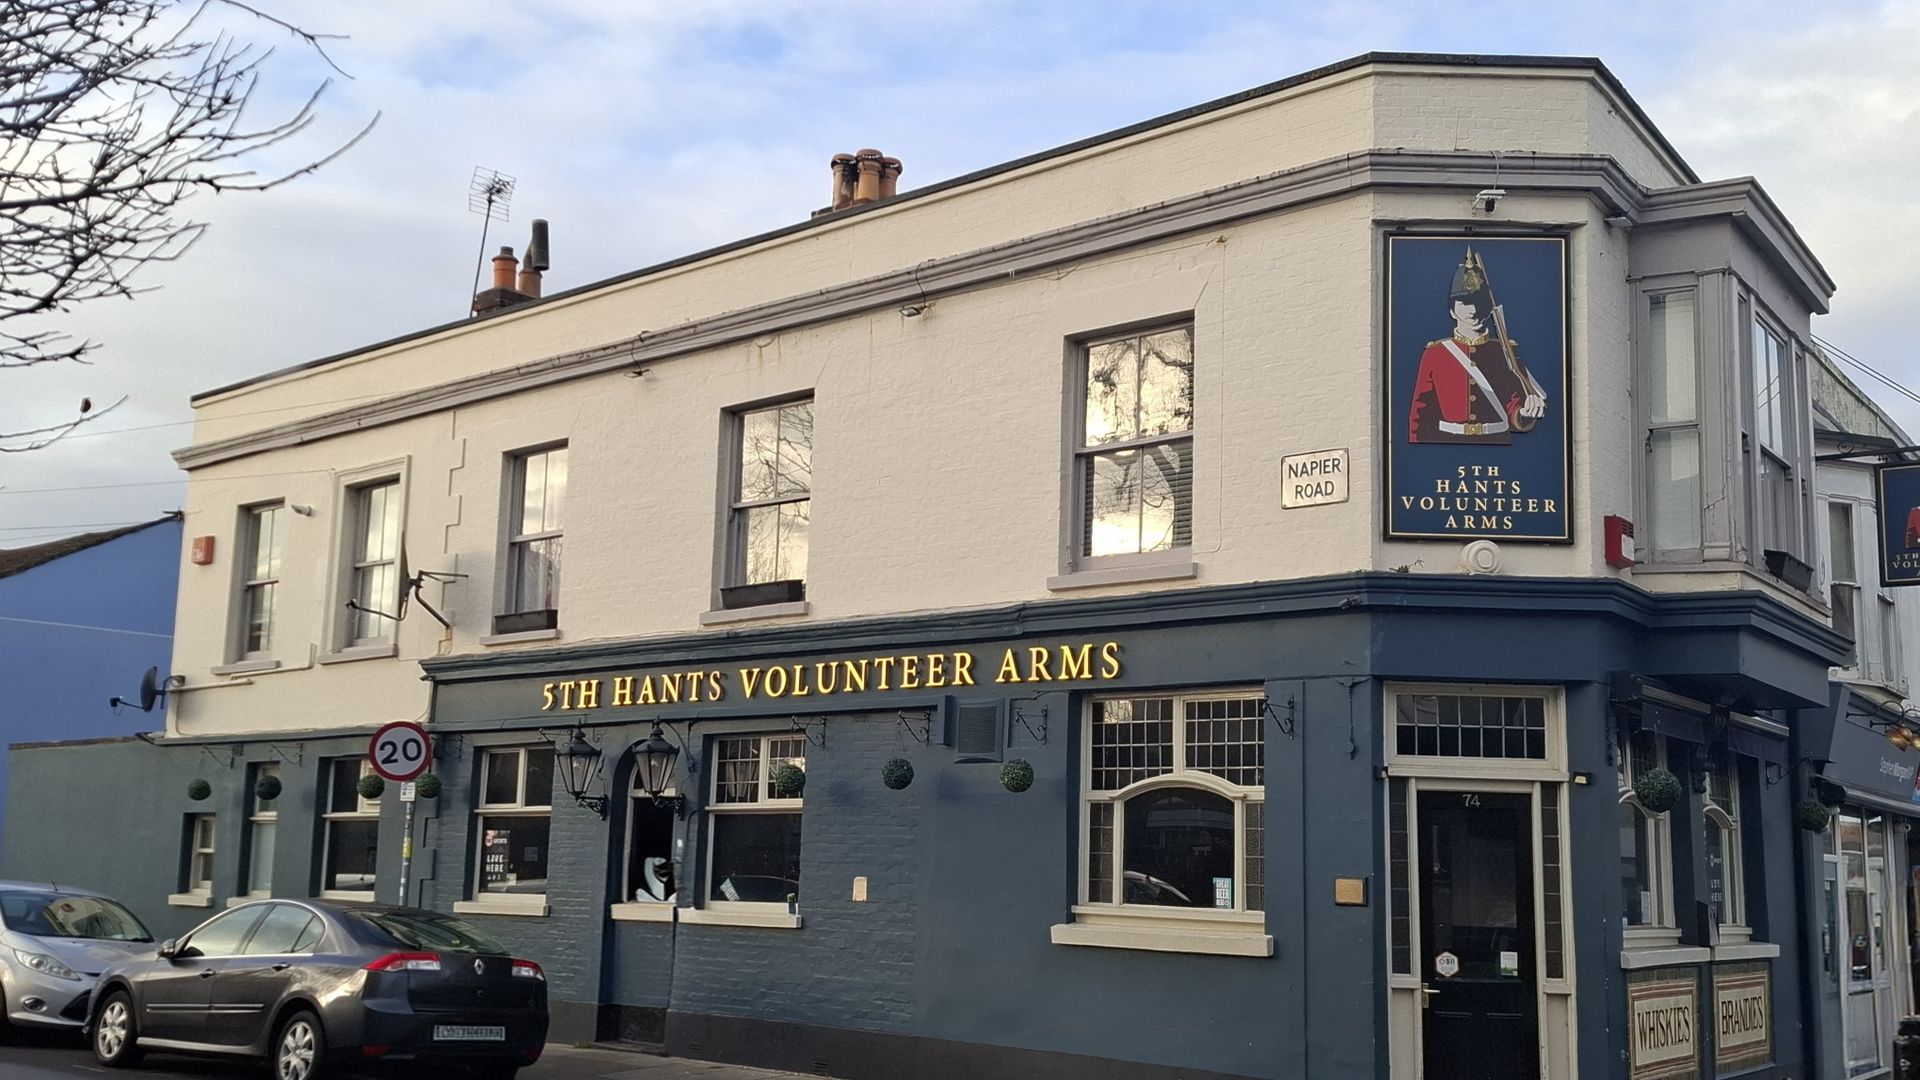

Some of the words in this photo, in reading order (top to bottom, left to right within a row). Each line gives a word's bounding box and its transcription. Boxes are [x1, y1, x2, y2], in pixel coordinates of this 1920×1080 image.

[1288, 457, 1342, 479] NAPIER
[1457, 465, 1500, 478] 5TH
[1295, 480, 1335, 500] ROAD
[1436, 479, 1521, 495] HANTS
[1401, 496, 1557, 513] VOLUNTEER
[1444, 514, 1513, 530] ARMS
[541, 678, 600, 711] 5TH
[611, 670, 723, 707] HANTS
[739, 651, 975, 699] VOLUNTEER
[995, 641, 1121, 684] ARMS
[379, 737, 422, 765] 20
[1462, 794, 1481, 808] 74
[486, 854, 504, 863] LIVE
[485, 864, 504, 872] HERE
[1721, 996, 1764, 1035] BRANDIES
[1637, 1005, 1691, 1052] WHISKIES
